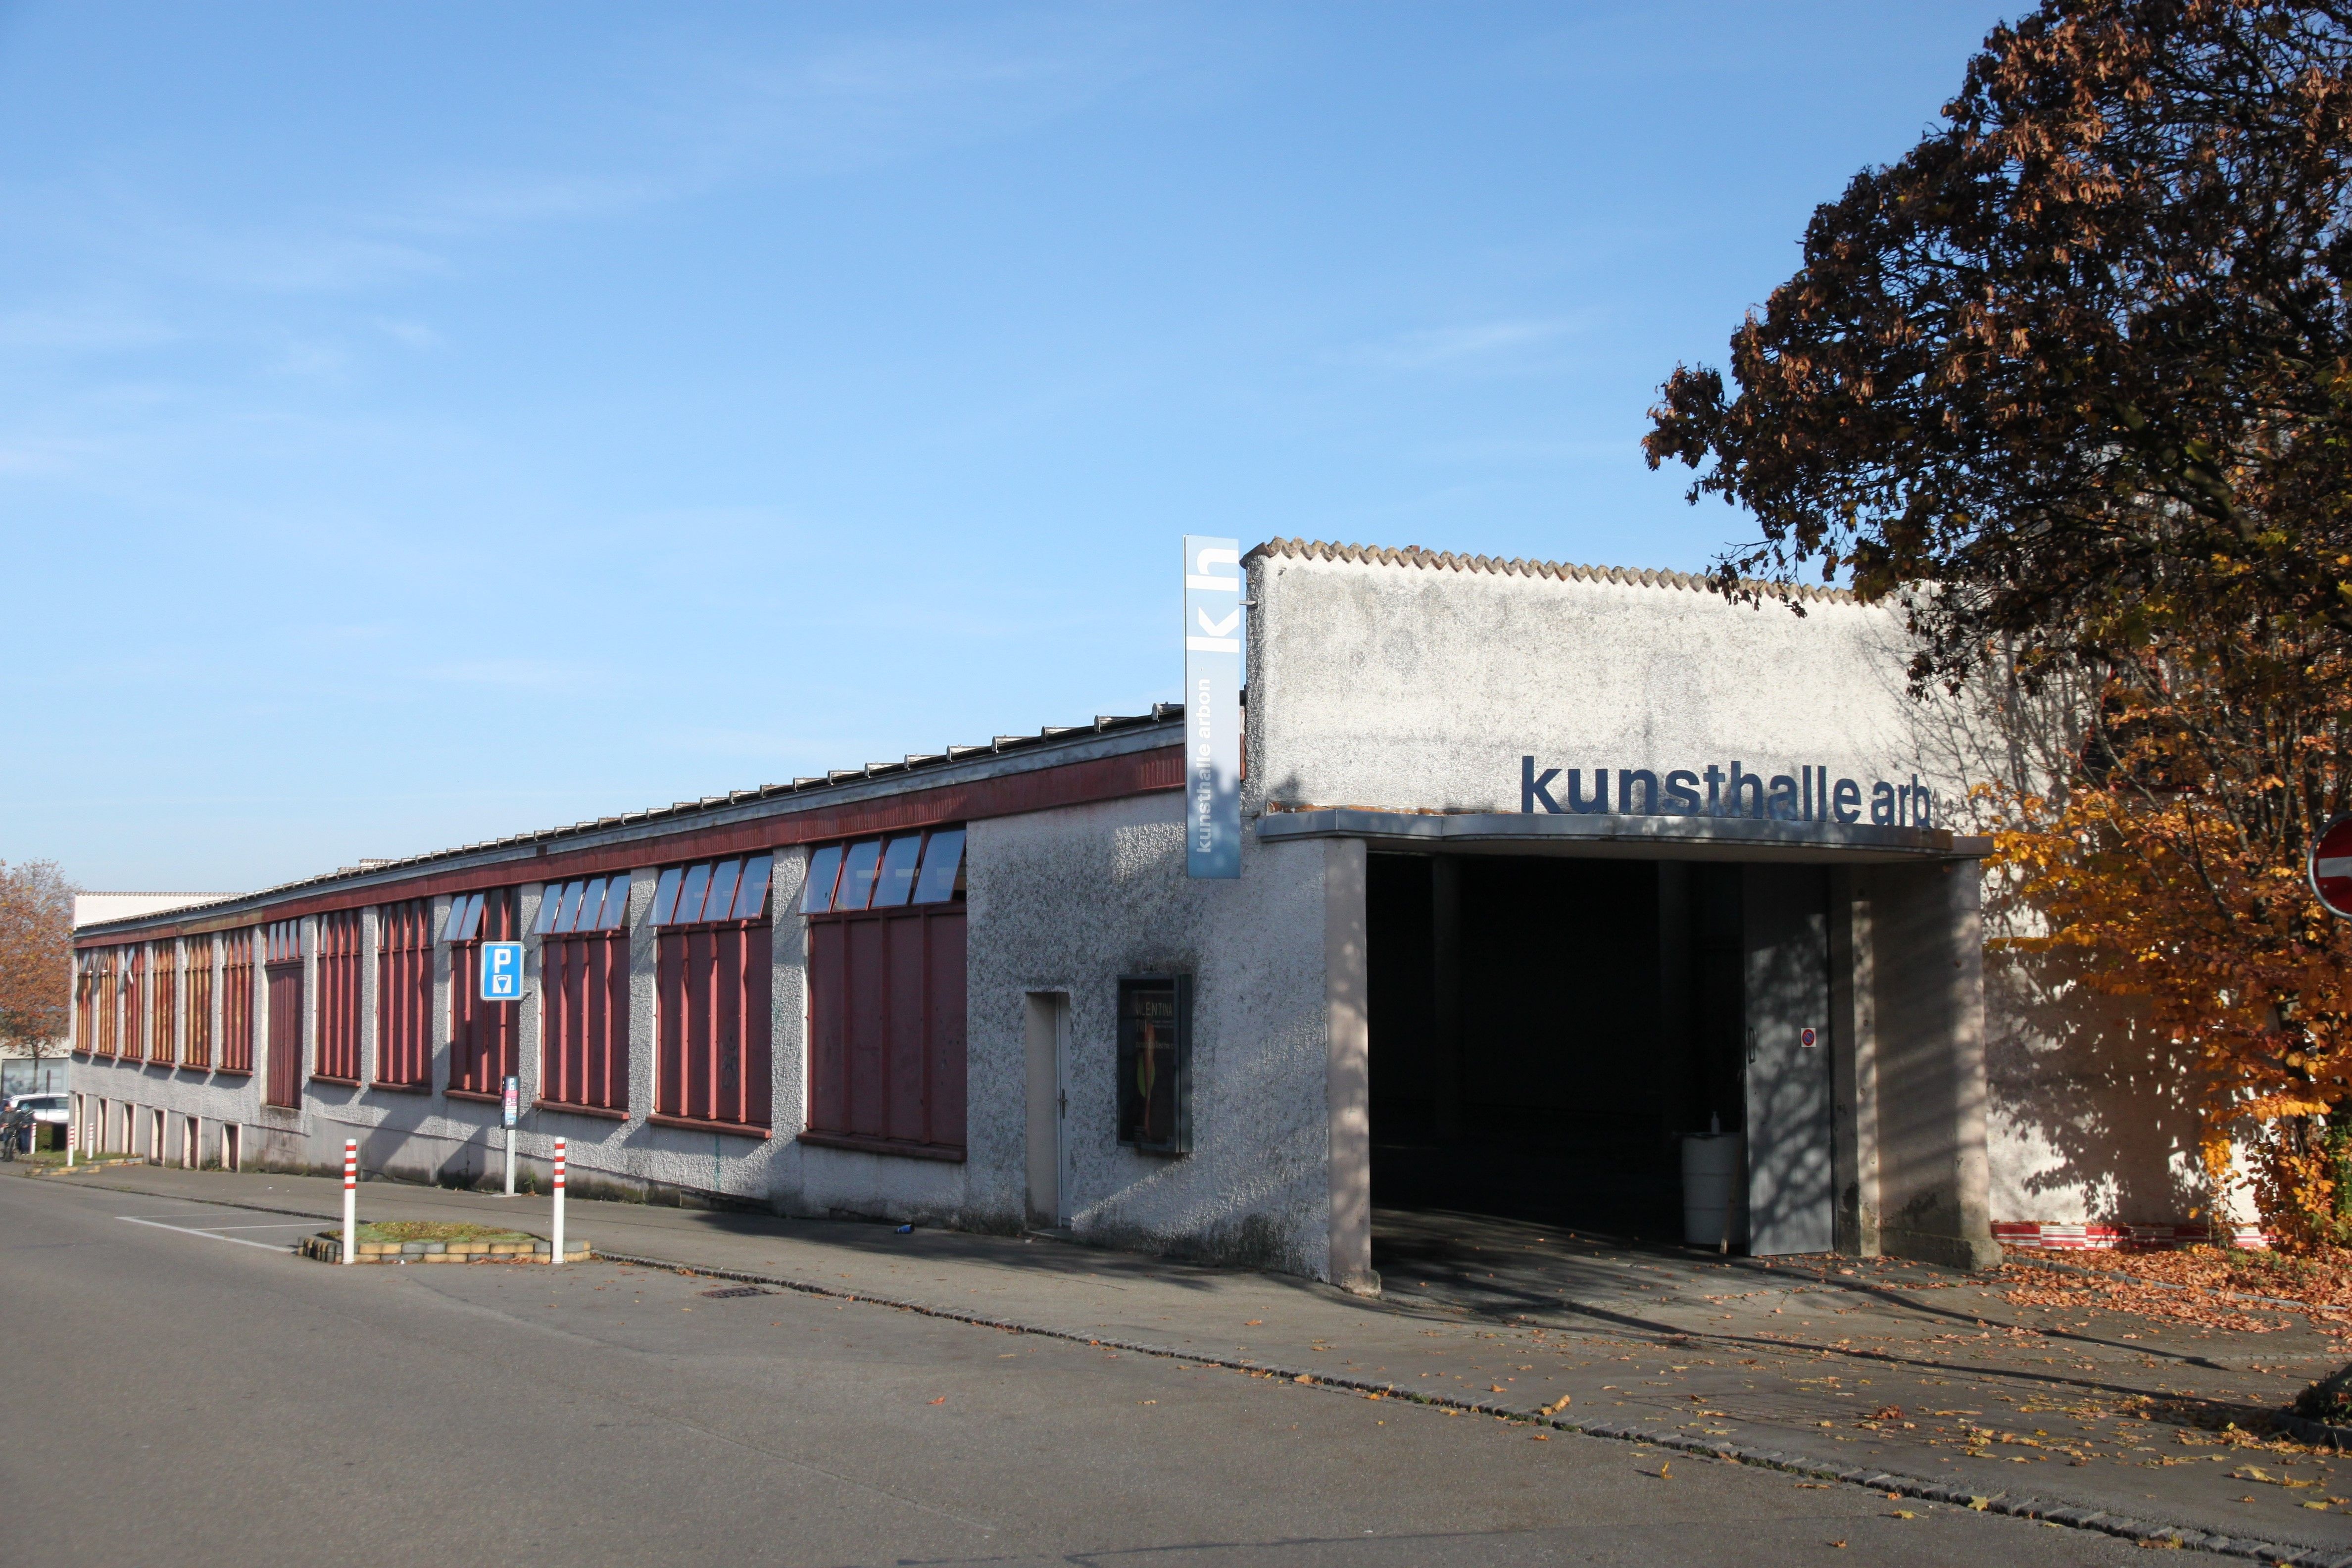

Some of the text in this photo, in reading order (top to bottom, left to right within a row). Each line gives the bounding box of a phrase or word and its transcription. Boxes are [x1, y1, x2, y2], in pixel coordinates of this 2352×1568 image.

[1196, 679, 1211, 853] kunsthalle arbon
[1521, 755, 1862, 824] kunsthalle
[494, 948, 511, 974] P
